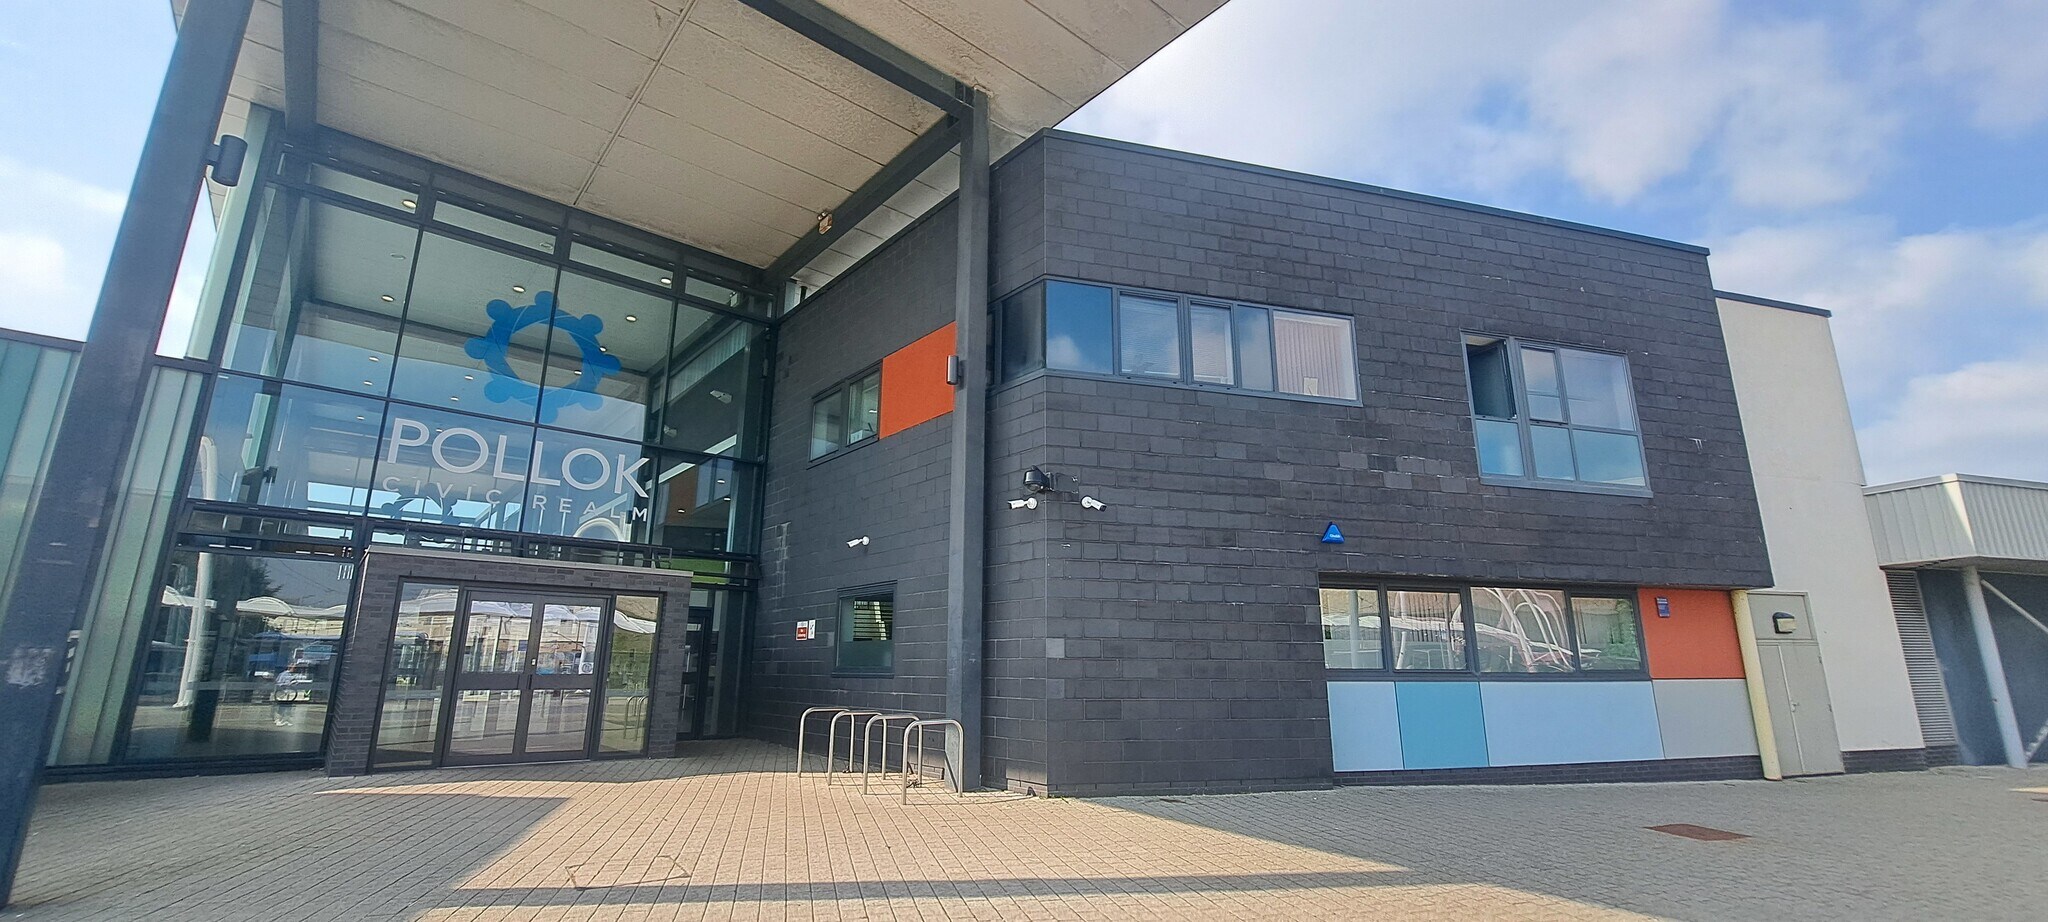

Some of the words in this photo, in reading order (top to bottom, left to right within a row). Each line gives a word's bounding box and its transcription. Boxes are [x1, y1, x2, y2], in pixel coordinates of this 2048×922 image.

[387, 417, 649, 498] POLLOK
[382, 476, 502, 505] CIVIC
[532, 494, 648, 522] REALM
